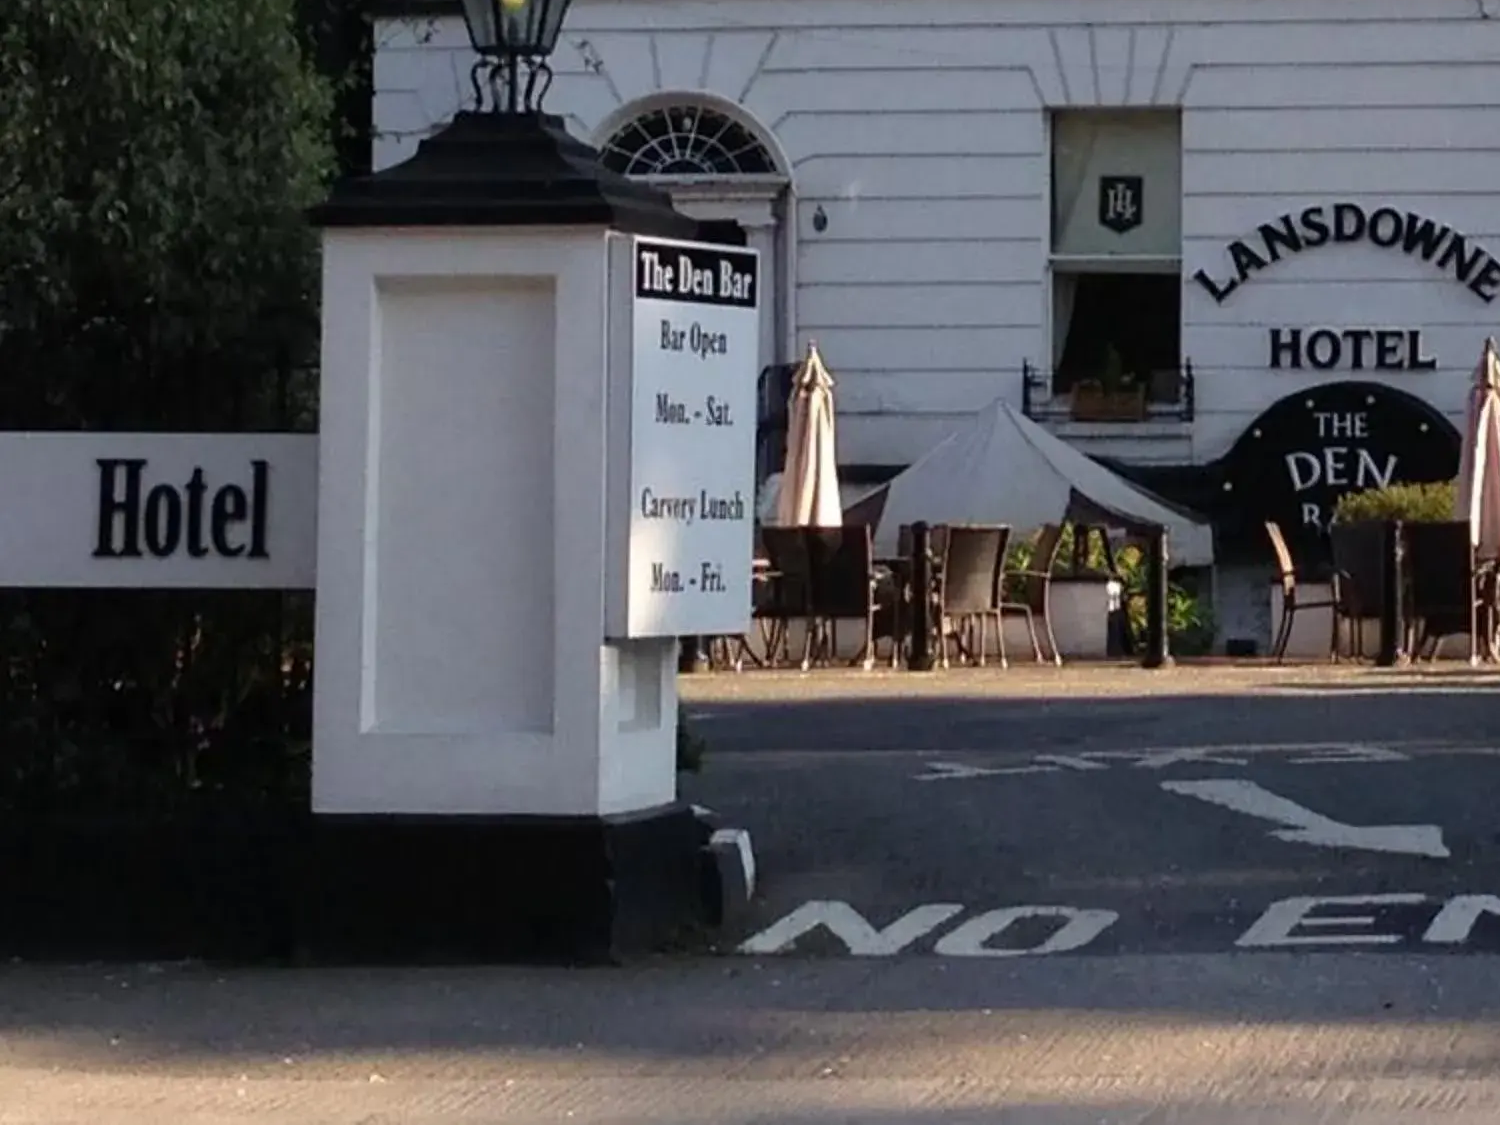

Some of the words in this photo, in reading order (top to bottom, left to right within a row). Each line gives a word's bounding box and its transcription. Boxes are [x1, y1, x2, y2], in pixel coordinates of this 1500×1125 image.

[641, 251, 674, 293] The
[678, 254, 713, 296] Den
[719, 258, 753, 299] Bar
[660, 319, 686, 352] Bar
[690, 321, 727, 360] Open
[1270, 329, 1436, 369] HOTEL
[655, 392, 690, 424] Mon.
[706, 395, 734, 426] Sat.
[1313, 412, 1369, 438] THE
[1285, 447, 1398, 491] DEN
[91, 458, 270, 559] Hotel
[641, 487, 697, 525] Carvery
[700, 489, 745, 520] Lunch
[651, 562, 684, 592] Mon.
[700, 562, 726, 592] Fri.
[737, 900, 1120, 956] NO
